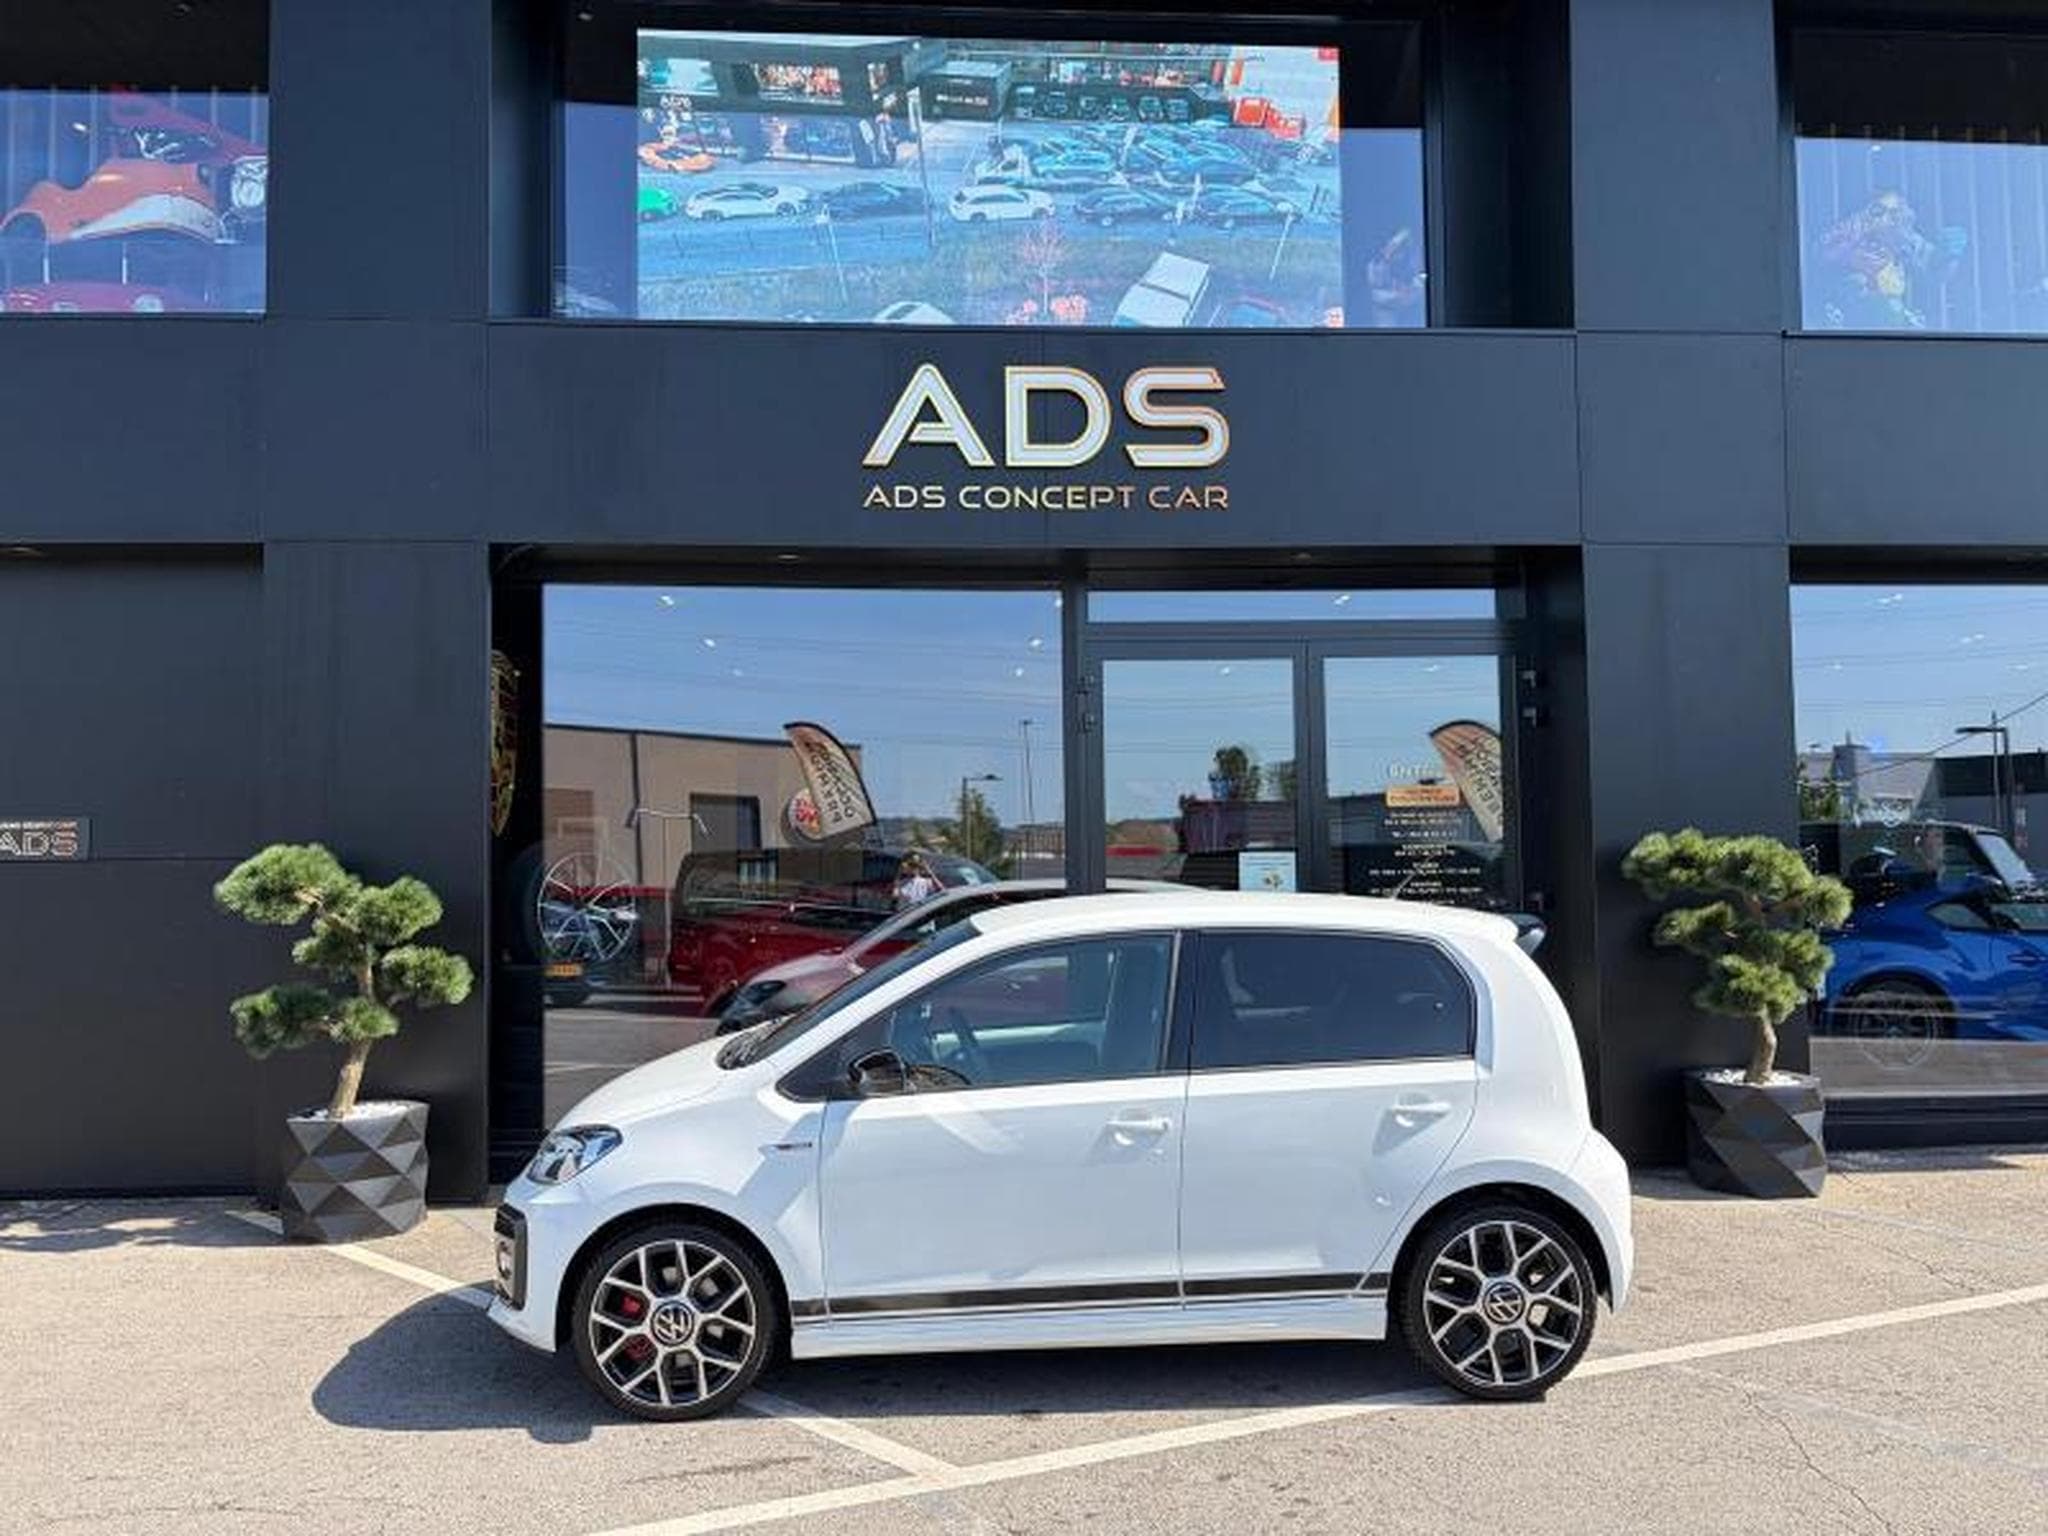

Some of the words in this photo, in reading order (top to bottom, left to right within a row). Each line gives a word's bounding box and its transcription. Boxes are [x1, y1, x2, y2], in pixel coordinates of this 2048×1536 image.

[863, 363, 1230, 468] ADS
[863, 485, 946, 509] ADS
[958, 485, 1136, 509] CONCEPT
[1148, 485, 1230, 509] CAR
